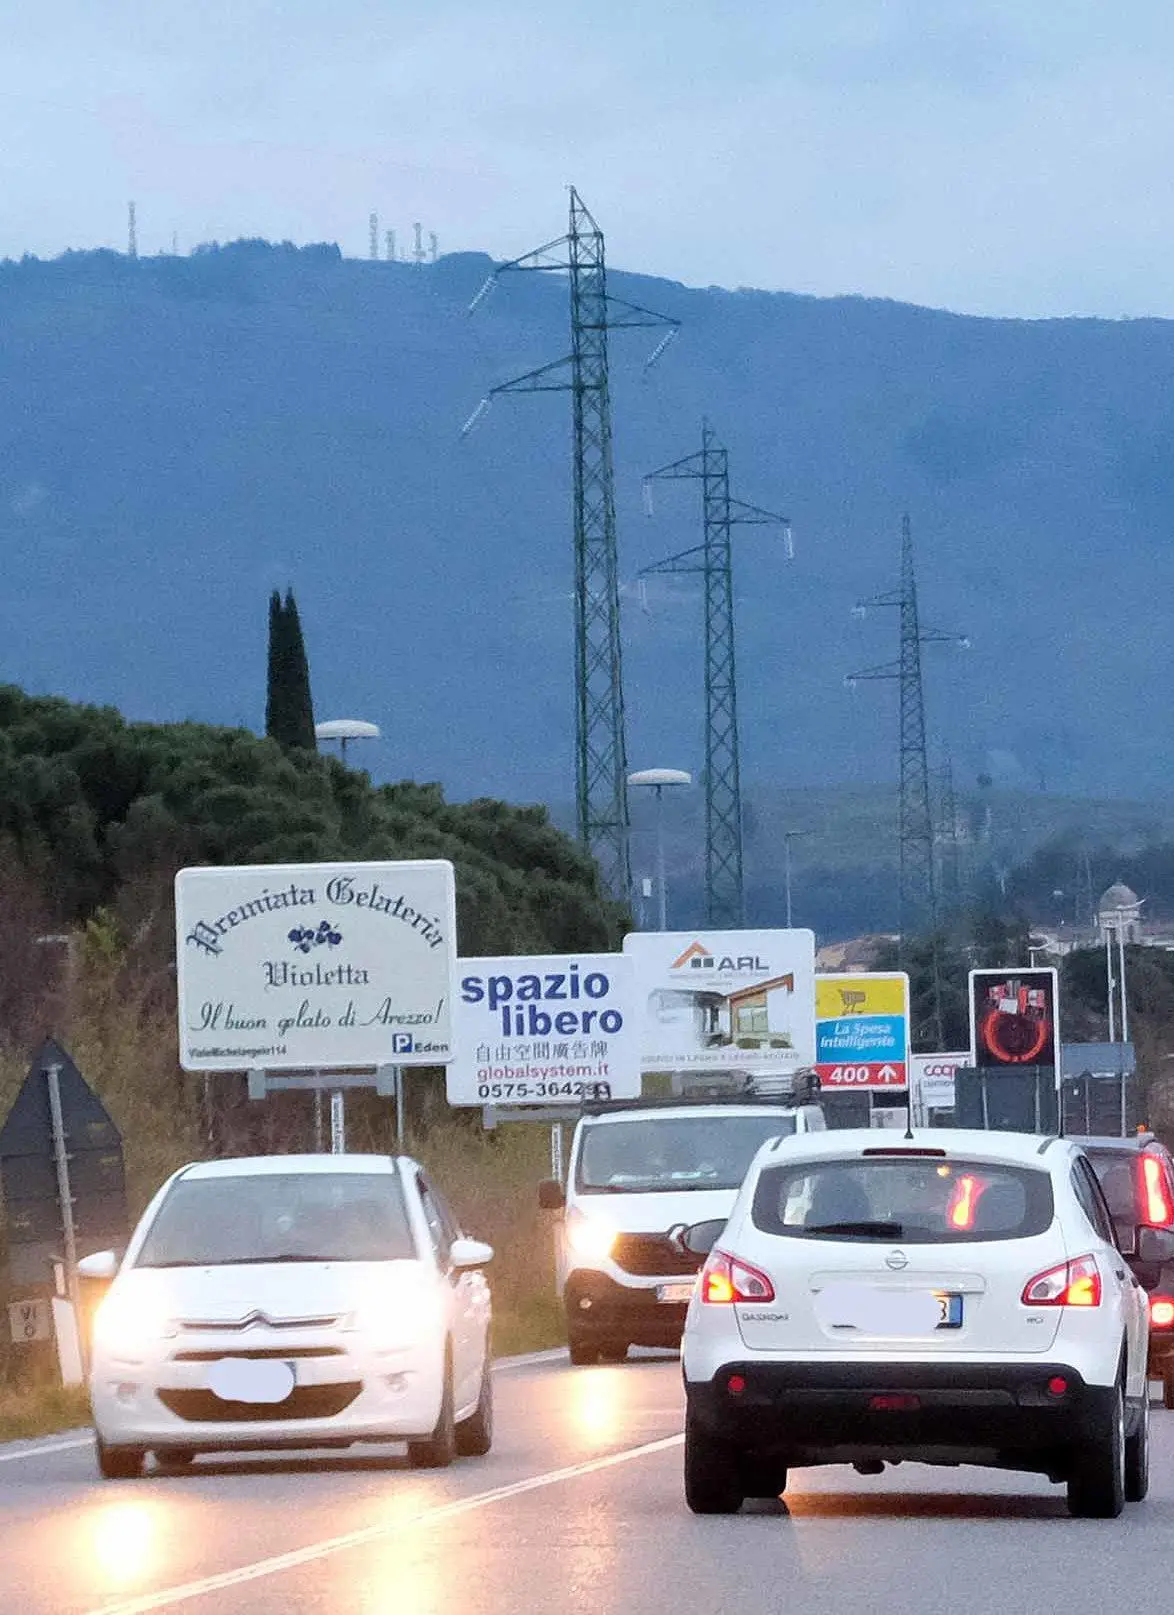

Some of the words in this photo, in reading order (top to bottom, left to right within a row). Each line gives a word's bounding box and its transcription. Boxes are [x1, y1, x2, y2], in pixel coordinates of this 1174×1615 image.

[186, 884, 315, 957] Premiata
[326, 876, 445, 950] Gelateria
[263, 960, 370, 993] Violetta
[717, 956, 770, 972] ARL
[461, 963, 610, 1011] spazio
[189, 1000, 223, 1032] Il
[223, 1003, 266, 1031] buon
[277, 998, 332, 1037] gelato
[338, 999, 357, 1028] di
[359, 996, 445, 1026] Arezzo!
[502, 1004, 624, 1037] libero
[834, 1022, 849, 1035] La
[854, 1021, 891, 1037] Spesa
[414, 1042, 449, 1053] Eden
[477, 1060, 609, 1083] globalsystem.it
[829, 1066, 870, 1084] 400
